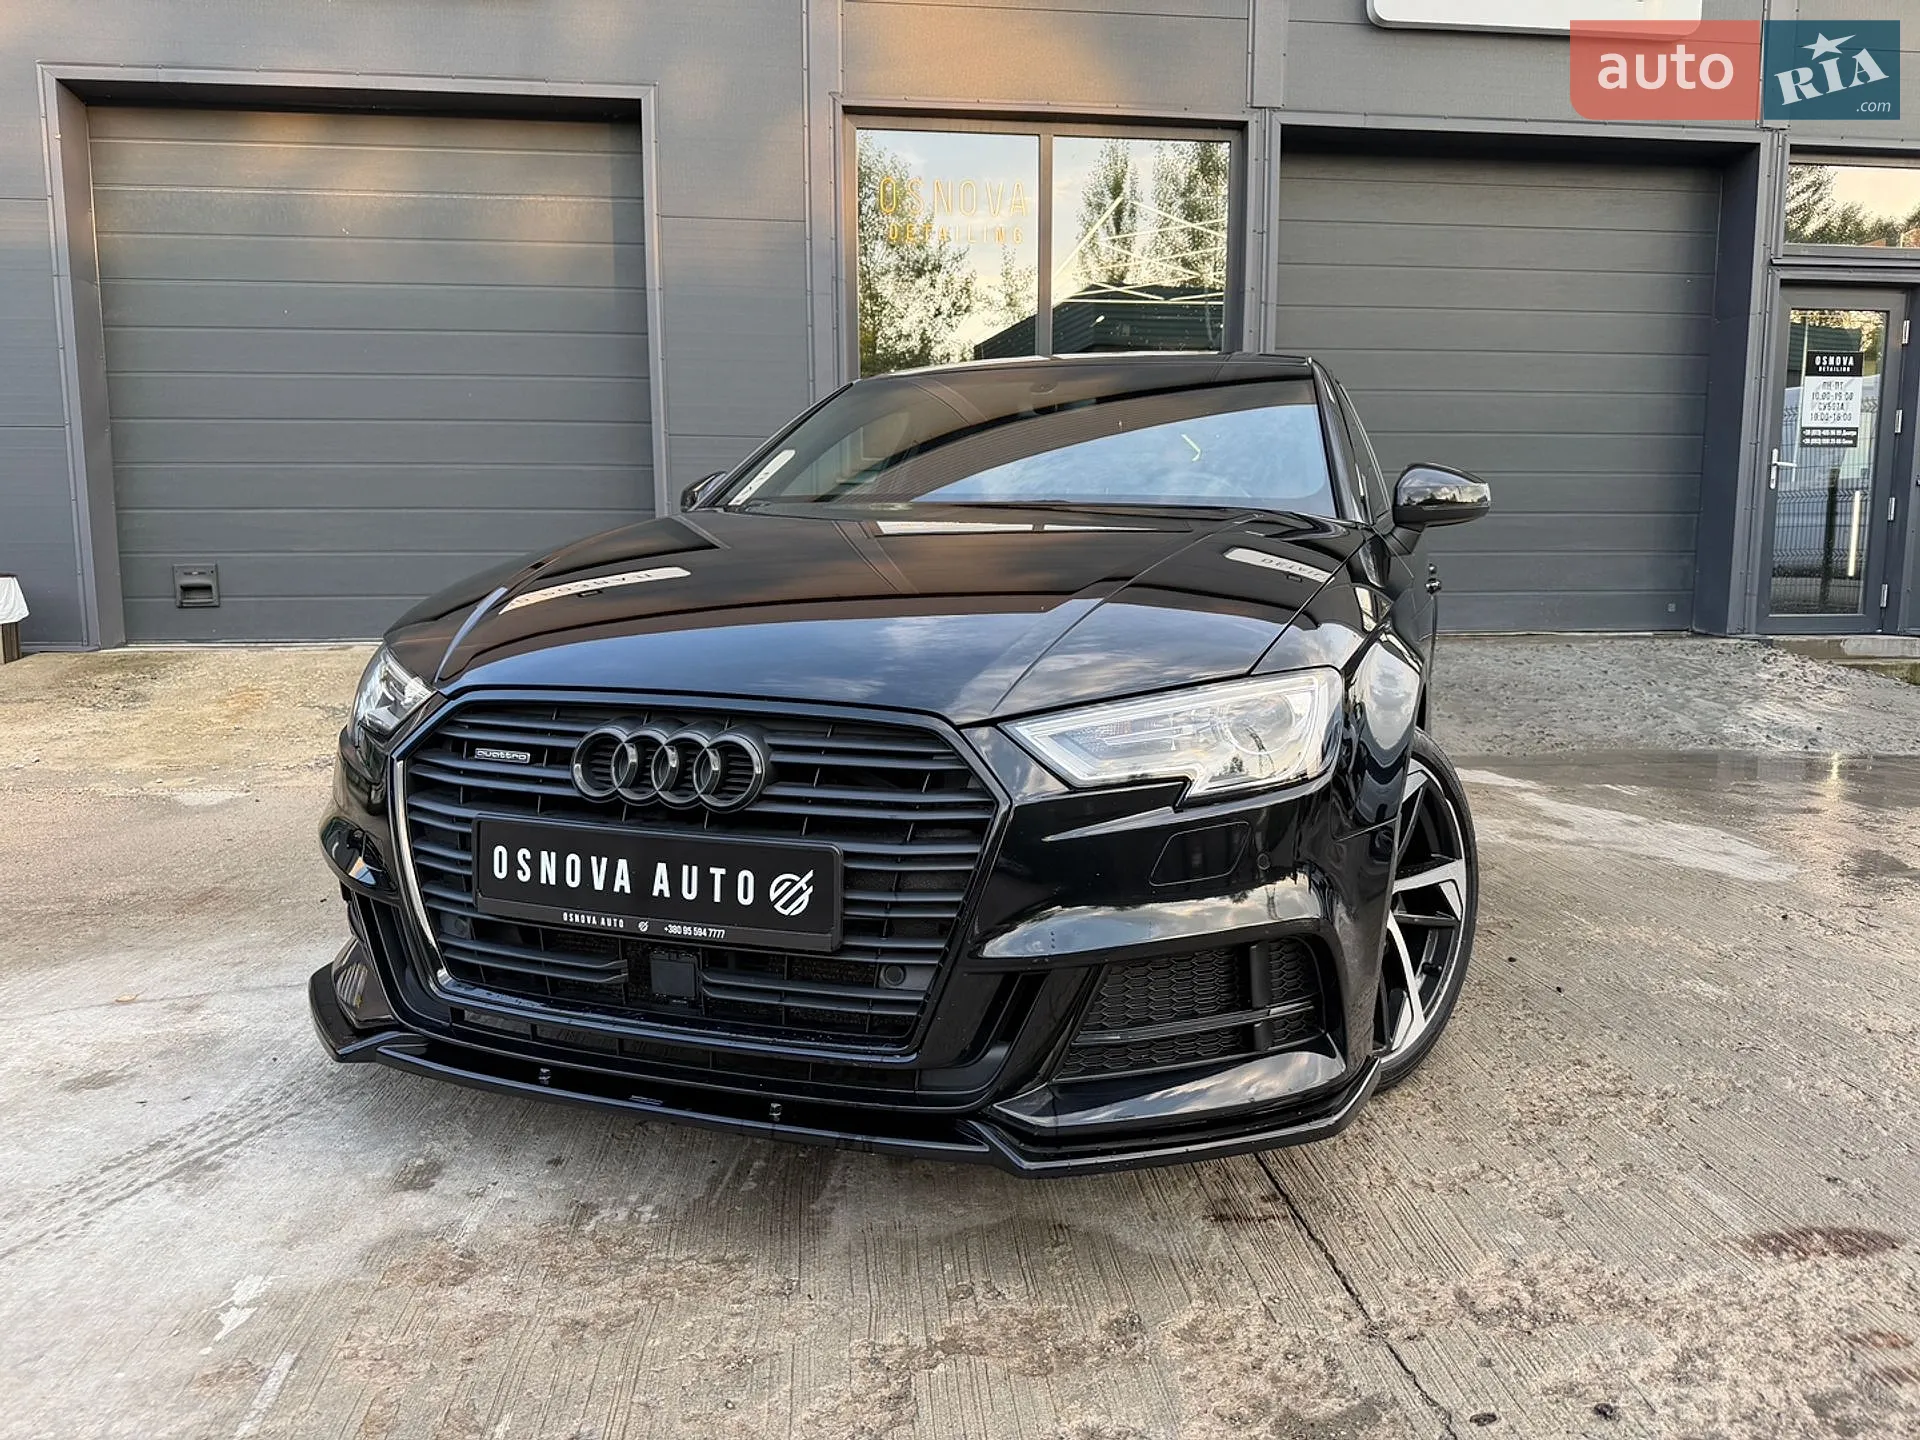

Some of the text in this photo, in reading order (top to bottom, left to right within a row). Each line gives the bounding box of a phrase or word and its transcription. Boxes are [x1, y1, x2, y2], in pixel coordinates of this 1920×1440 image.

[879, 176, 1027, 217] OSNOVA
[887, 223, 1024, 245] DETAILING
[1815, 356, 1854, 366] OSNOVA
[476, 750, 527, 760] quattro
[493, 844, 756, 906] OSNOVA AUTO
[562, 912, 597, 925] OSNOVA
[600, 917, 624, 928] AUTO
[683, 925, 692, 935] 95
[693, 926, 707, 937] 594
